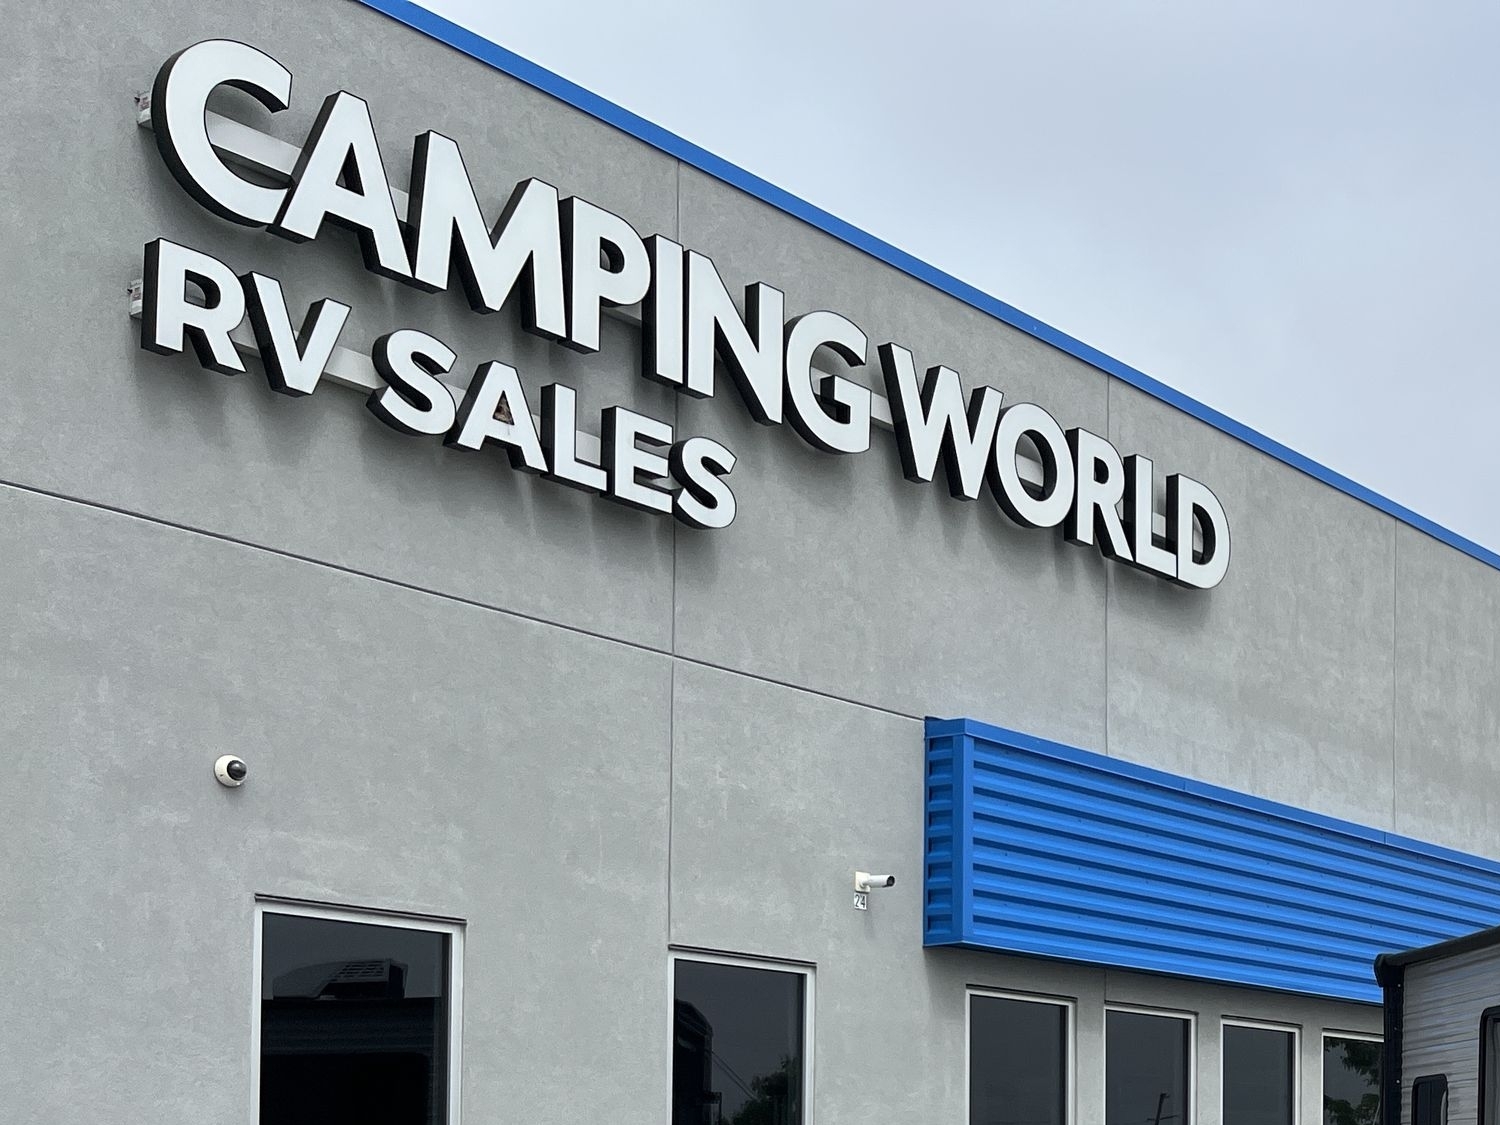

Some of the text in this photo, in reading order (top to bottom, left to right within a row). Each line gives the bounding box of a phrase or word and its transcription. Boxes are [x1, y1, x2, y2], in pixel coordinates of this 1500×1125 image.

[141, 237, 738, 530] RV SALES
[152, 38, 1232, 590] CAMPING WORLD
[854, 893, 867, 909] 24
